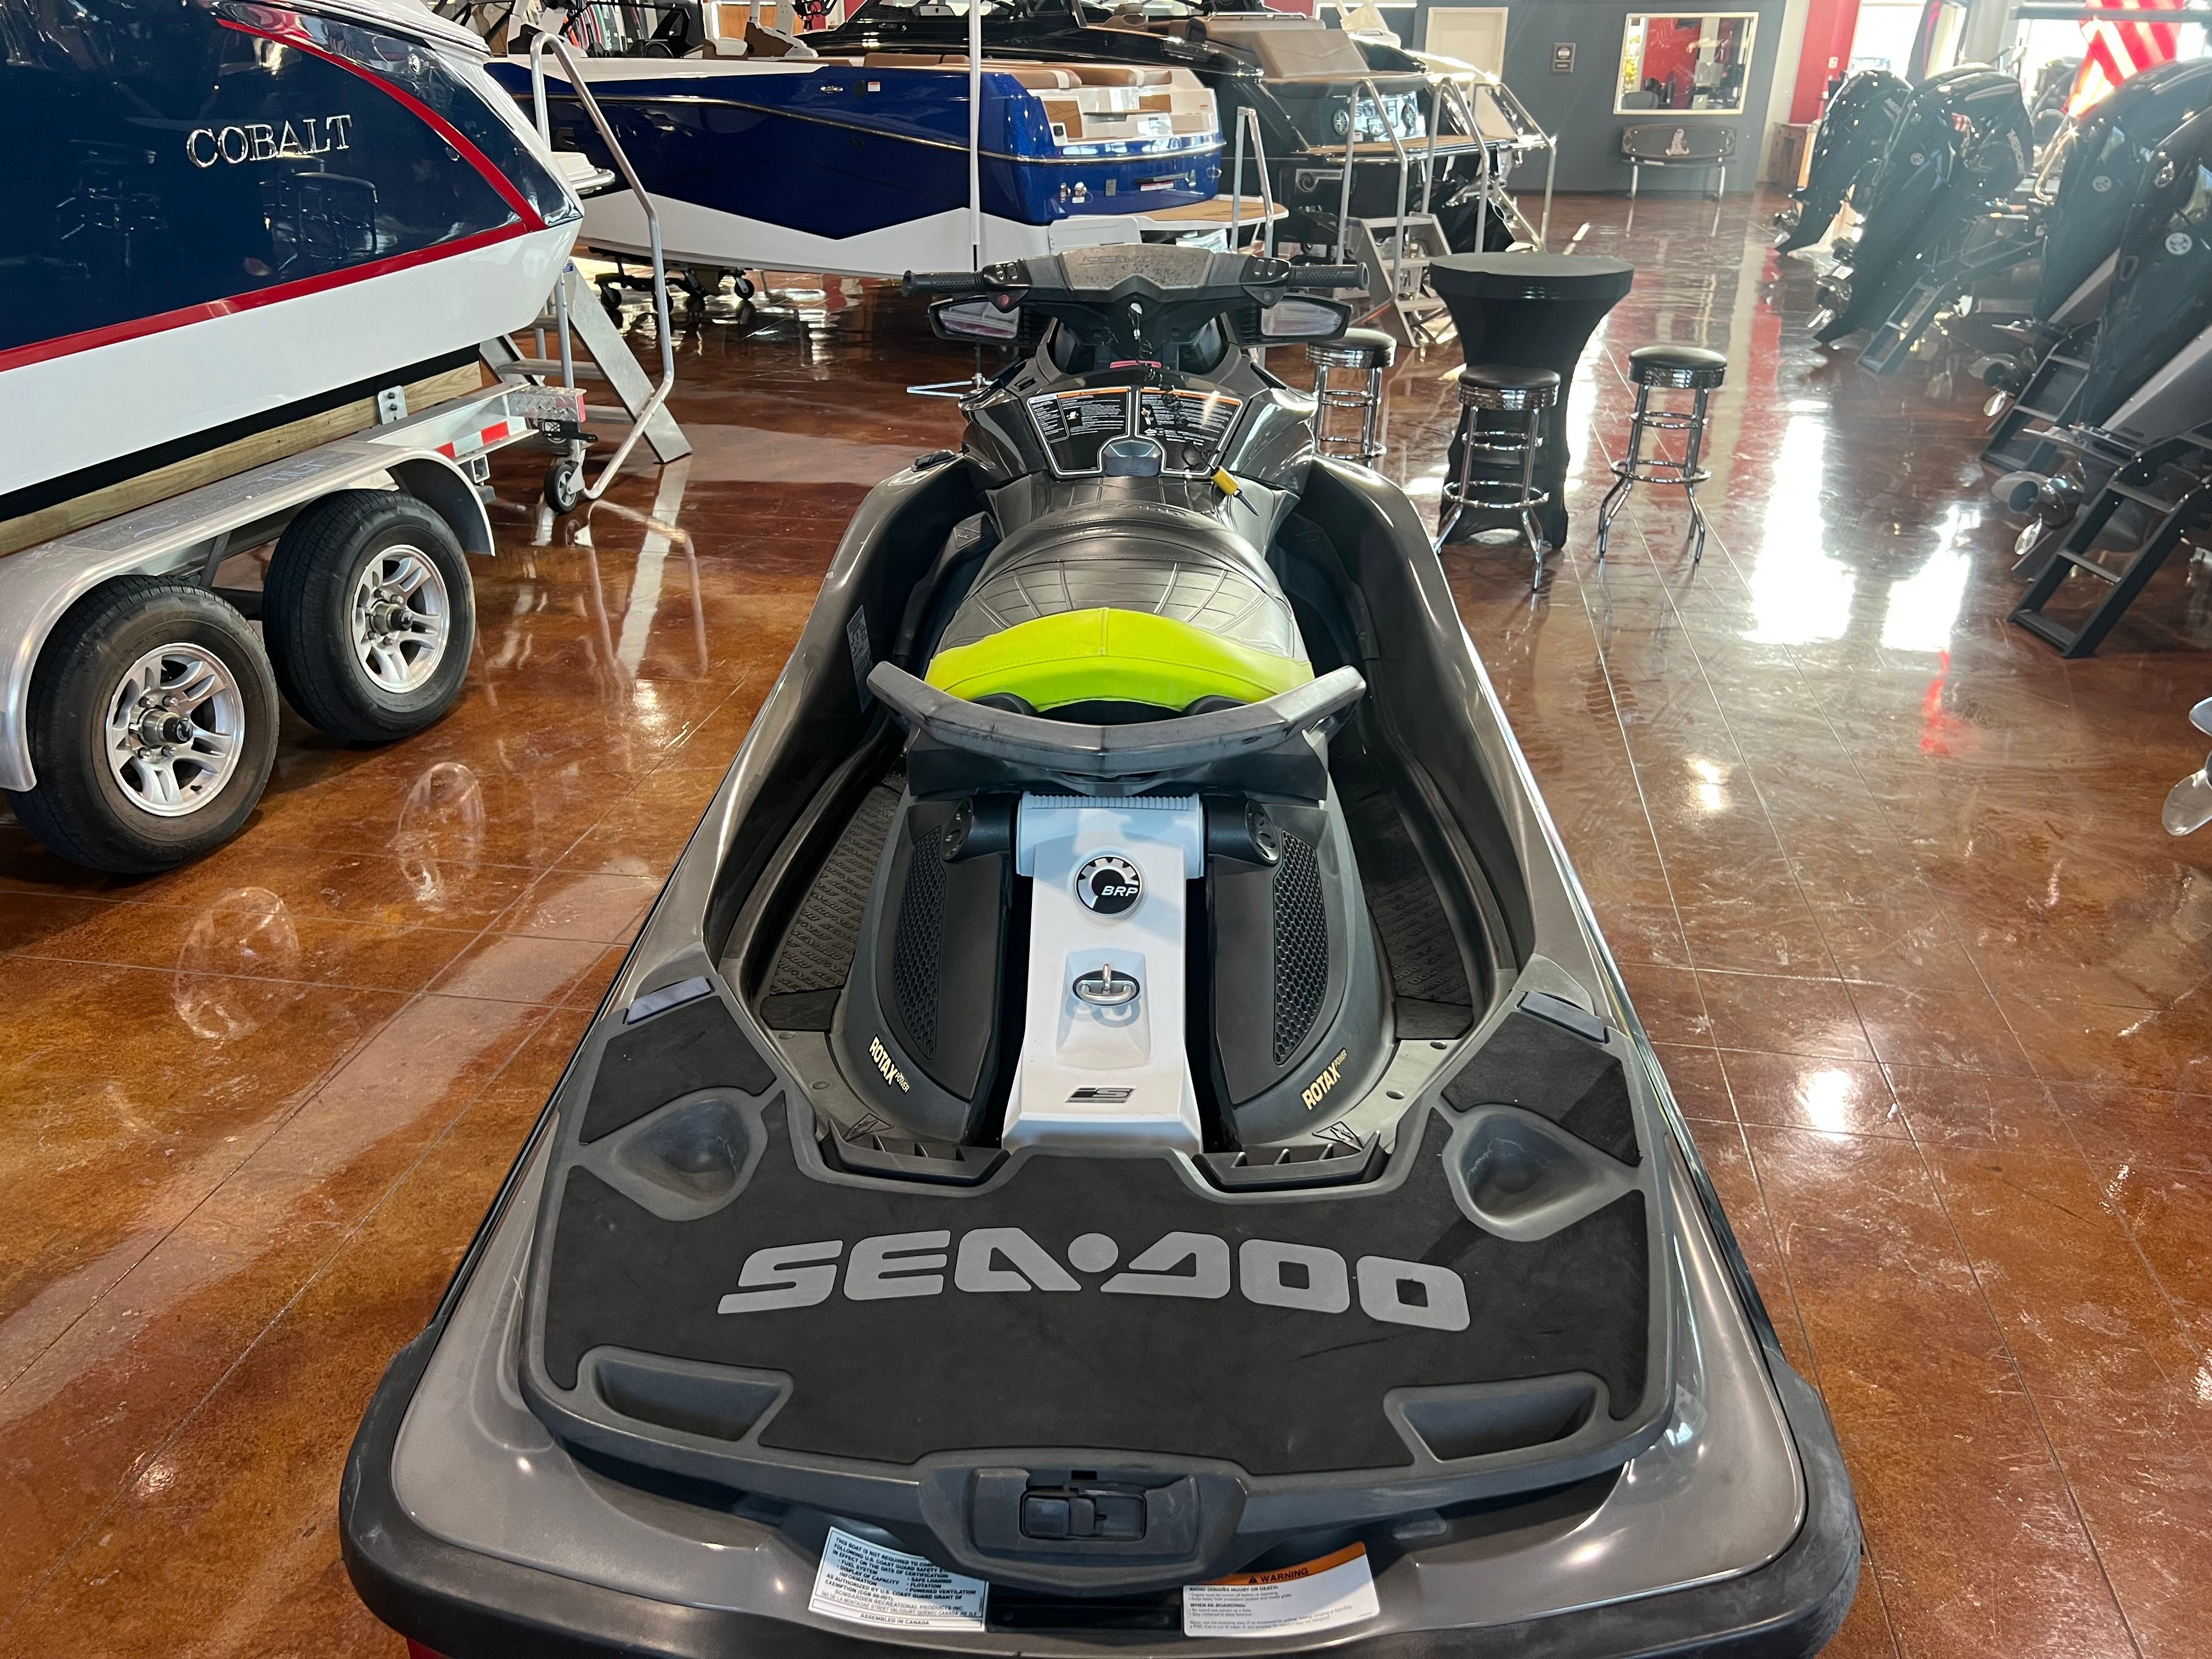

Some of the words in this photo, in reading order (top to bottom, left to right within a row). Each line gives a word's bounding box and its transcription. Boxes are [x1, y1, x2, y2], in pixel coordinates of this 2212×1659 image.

[187, 114, 353, 168] COBALT
[1101, 885, 1138, 896] BRP
[869, 1036, 899, 1085] ROTAX
[1301, 1062, 1341, 1110] ROTAX
[834, 1543, 864, 1558] FOLLOWING
[876, 1559, 894, 1567] COAST
[836, 1537, 847, 1546] THIS
[849, 1542, 861, 1551] BOAT
[882, 1555, 909, 1564] REQUIRED
[839, 1553, 858, 1562] EFFECT
[840, 1565, 862, 1576] DISPLAY
[872, 1576, 900, 1585] CAPACITY
[842, 1559, 855, 1568] FUEL
[856, 1565, 878, 1575] SYSTEM
[1260, 1567, 1308, 1583] WARNING
[825, 1579, 856, 1593] EXEMPTION
[834, 1576, 870, 1590] AUTHORIZED
[839, 1572, 877, 1586] INFORMATION
[835, 1589, 873, 1602] BOMBARDIER
[874, 1599, 918, 1609] RECREATIONAL
[844, 1597, 870, 1607] MONTAGNE
[860, 1613, 896, 1623] ASSEMBLED
